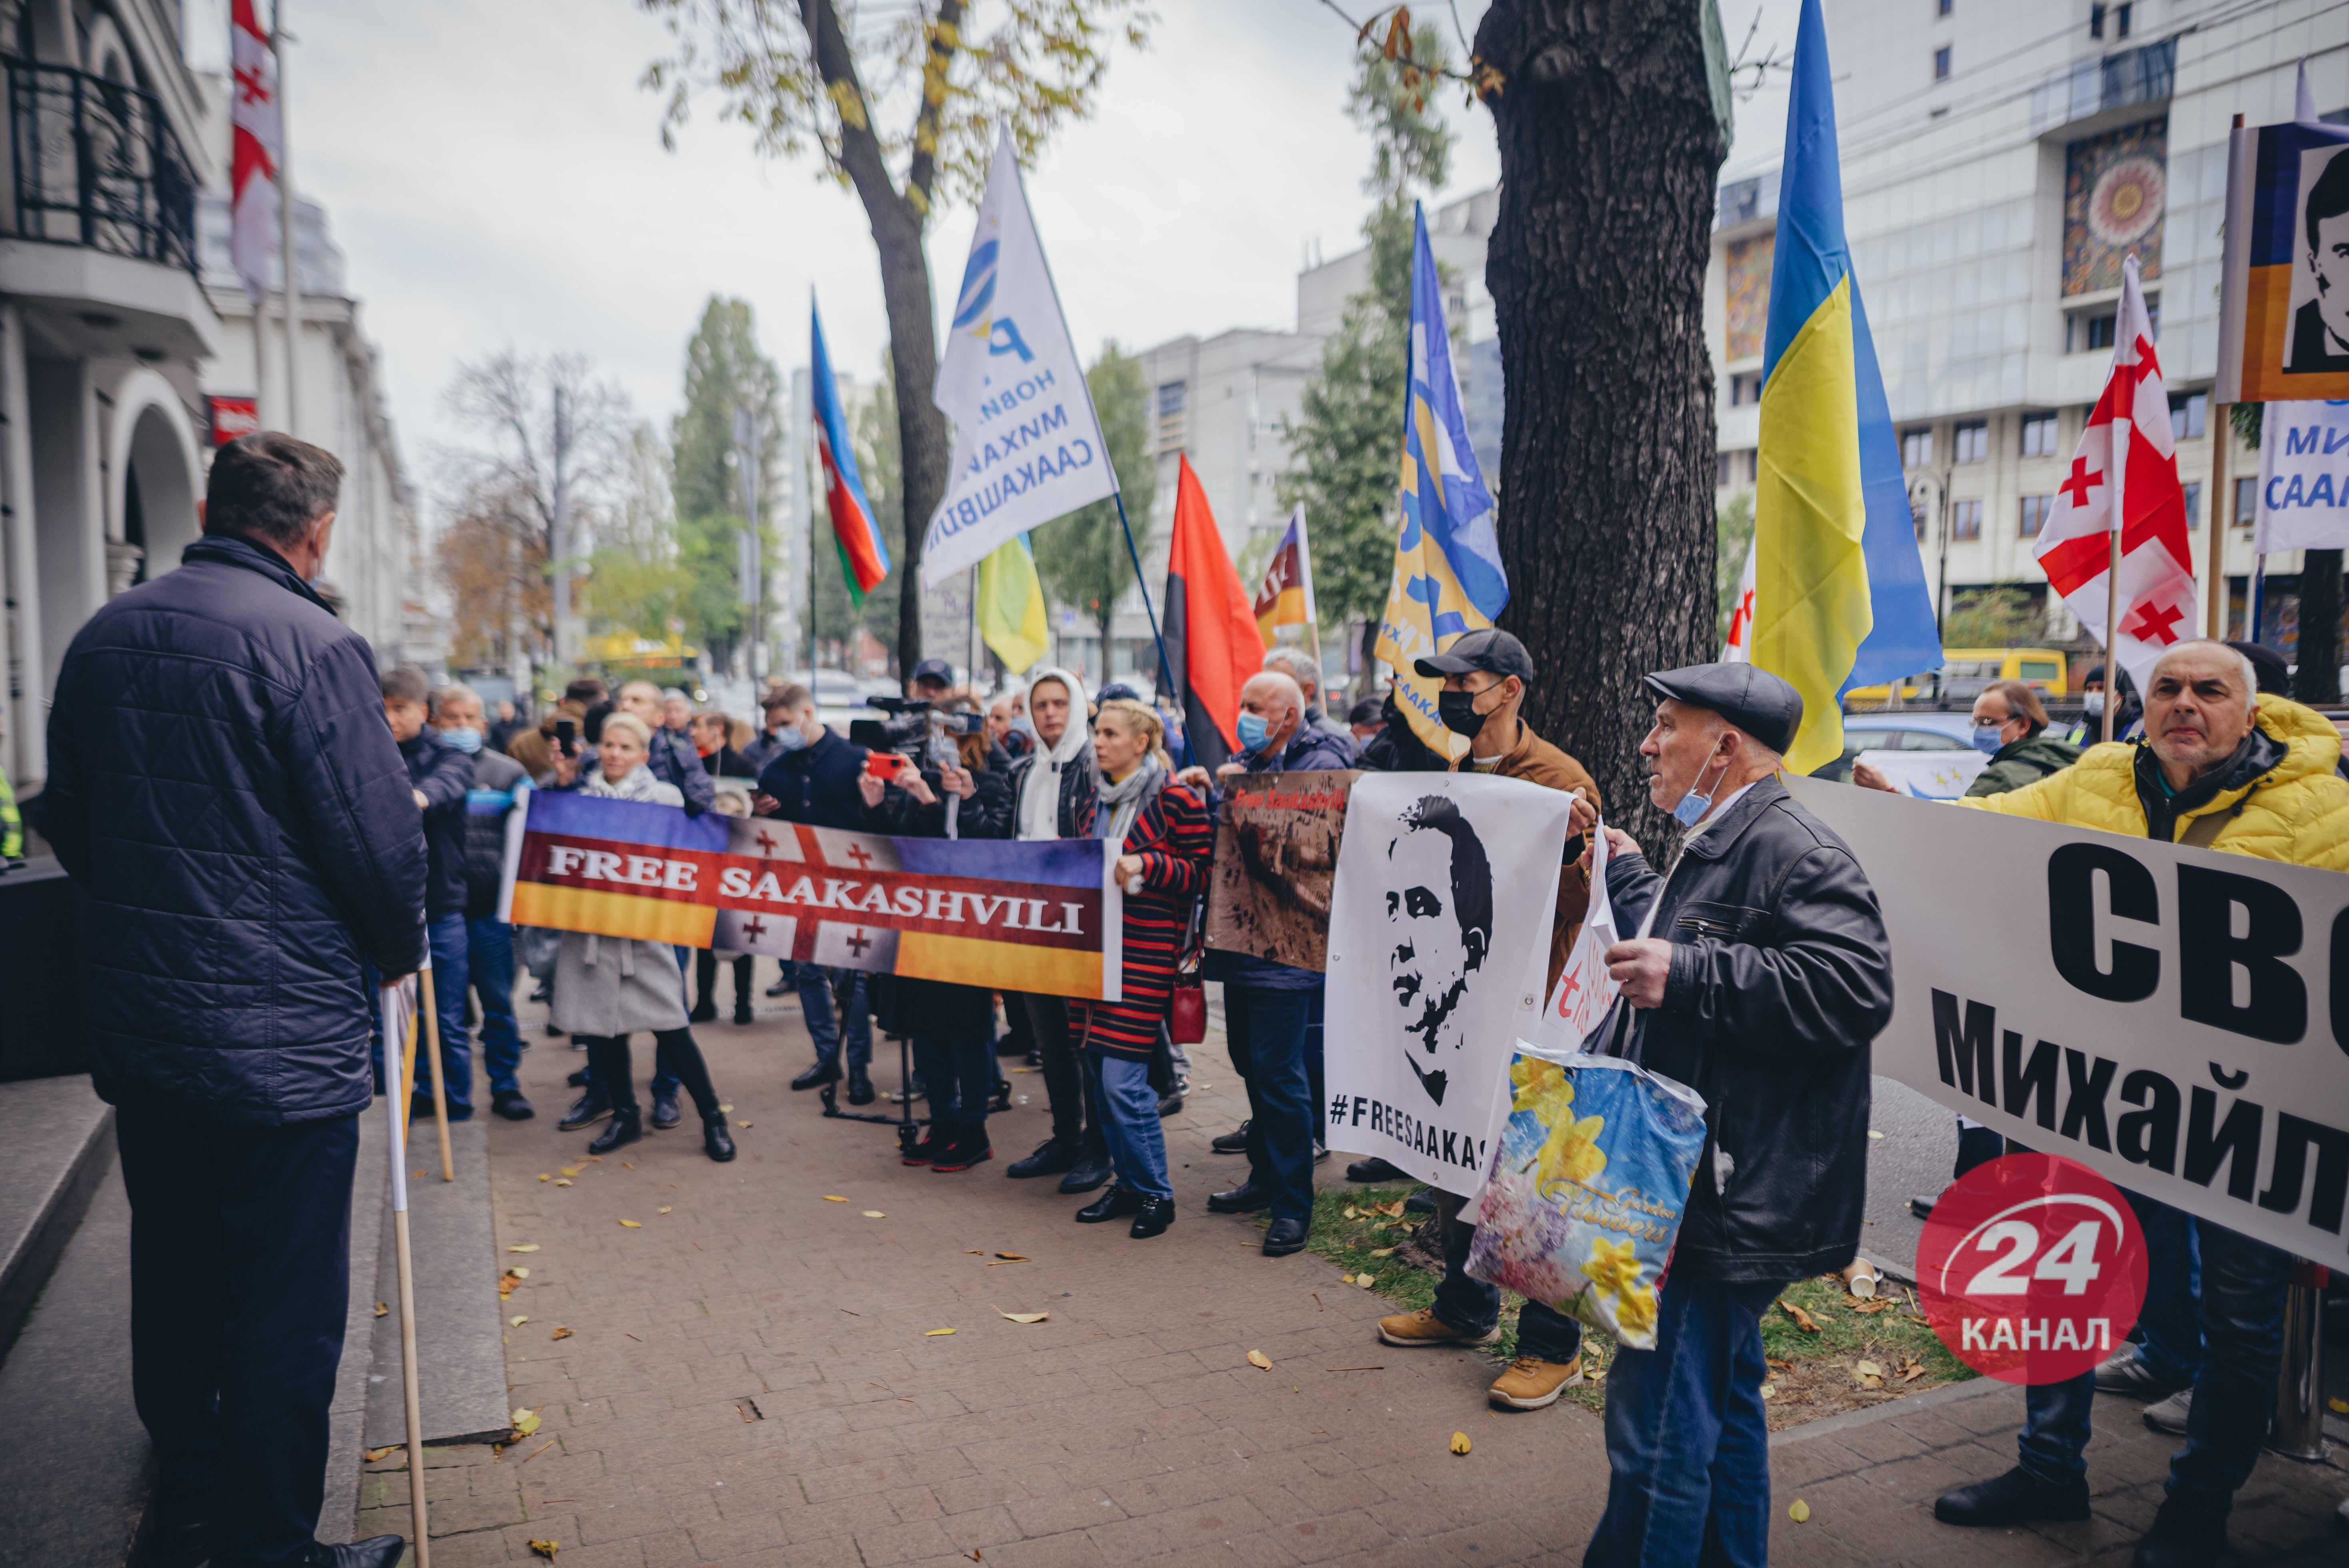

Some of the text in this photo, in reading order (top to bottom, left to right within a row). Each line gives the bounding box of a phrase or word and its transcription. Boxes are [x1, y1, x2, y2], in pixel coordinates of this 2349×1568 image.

[1395, 673, 1443, 727] СААКА
[1233, 789, 1345, 810] Free Saakashvili
[547, 845, 1084, 934] FREE SAAKASHVILI
[2048, 842, 2349, 1058] СВ
[1931, 987, 2349, 1236] Михайл
[1539, 1180, 1670, 1243] Flowers
[1602, 1186, 1677, 1220] Garden
